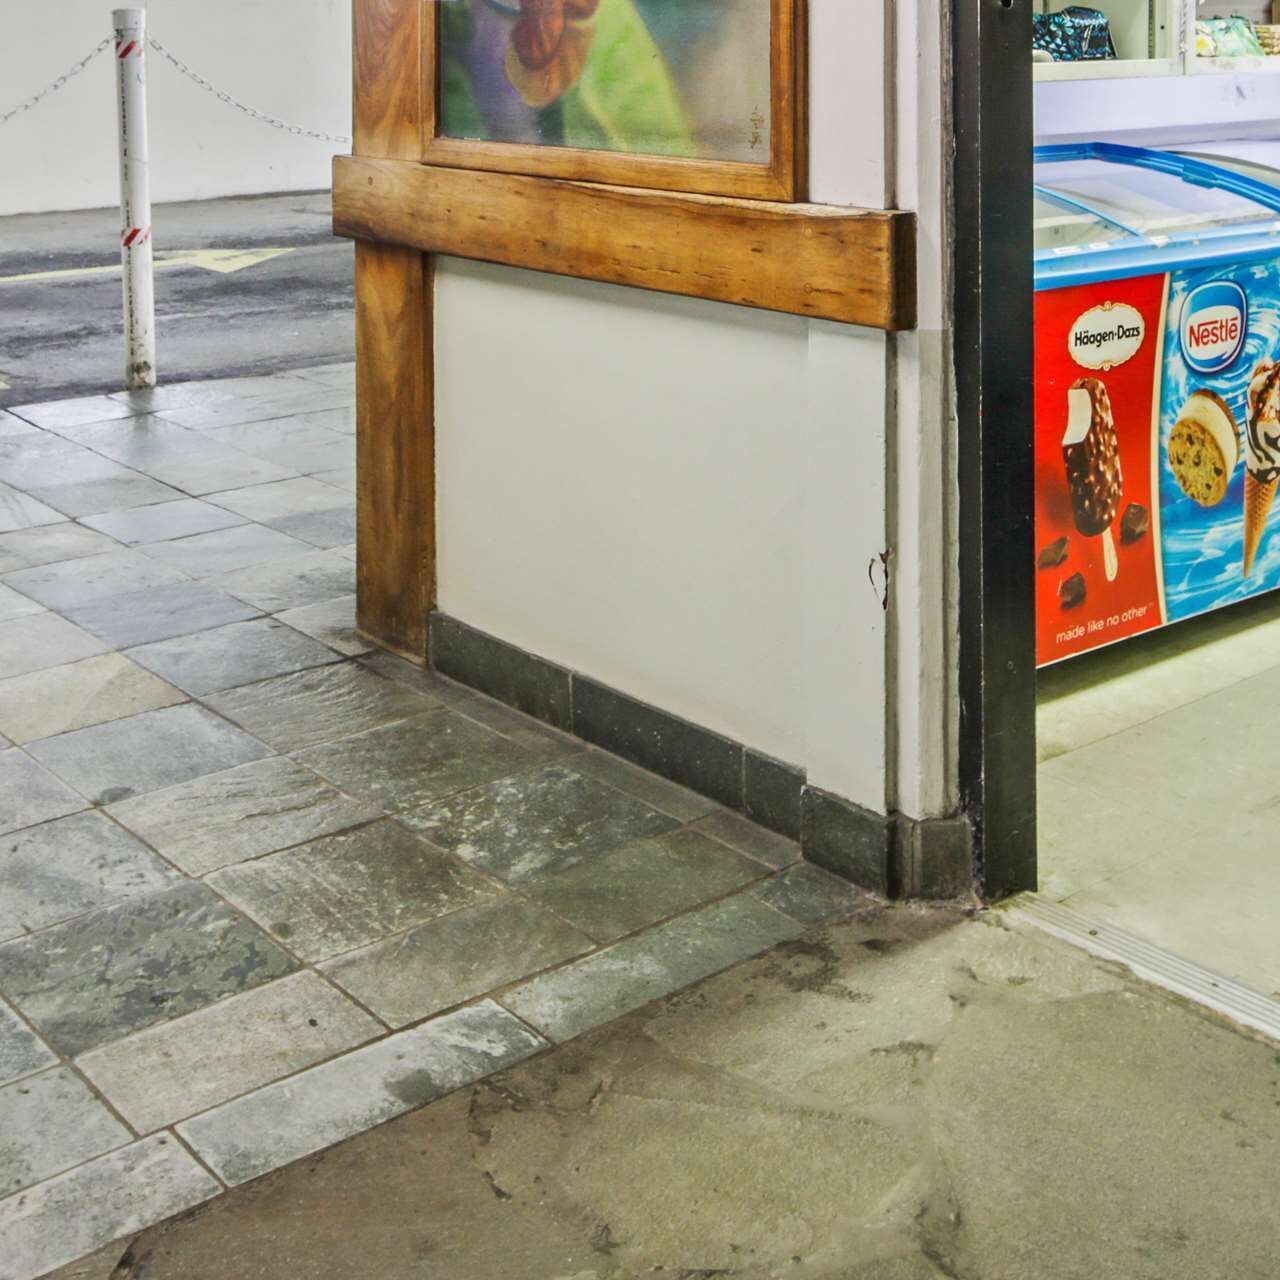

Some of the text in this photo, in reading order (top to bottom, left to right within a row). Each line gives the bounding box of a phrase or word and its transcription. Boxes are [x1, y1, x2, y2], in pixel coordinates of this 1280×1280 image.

[1056, 605, 1147, 643] made like no other
